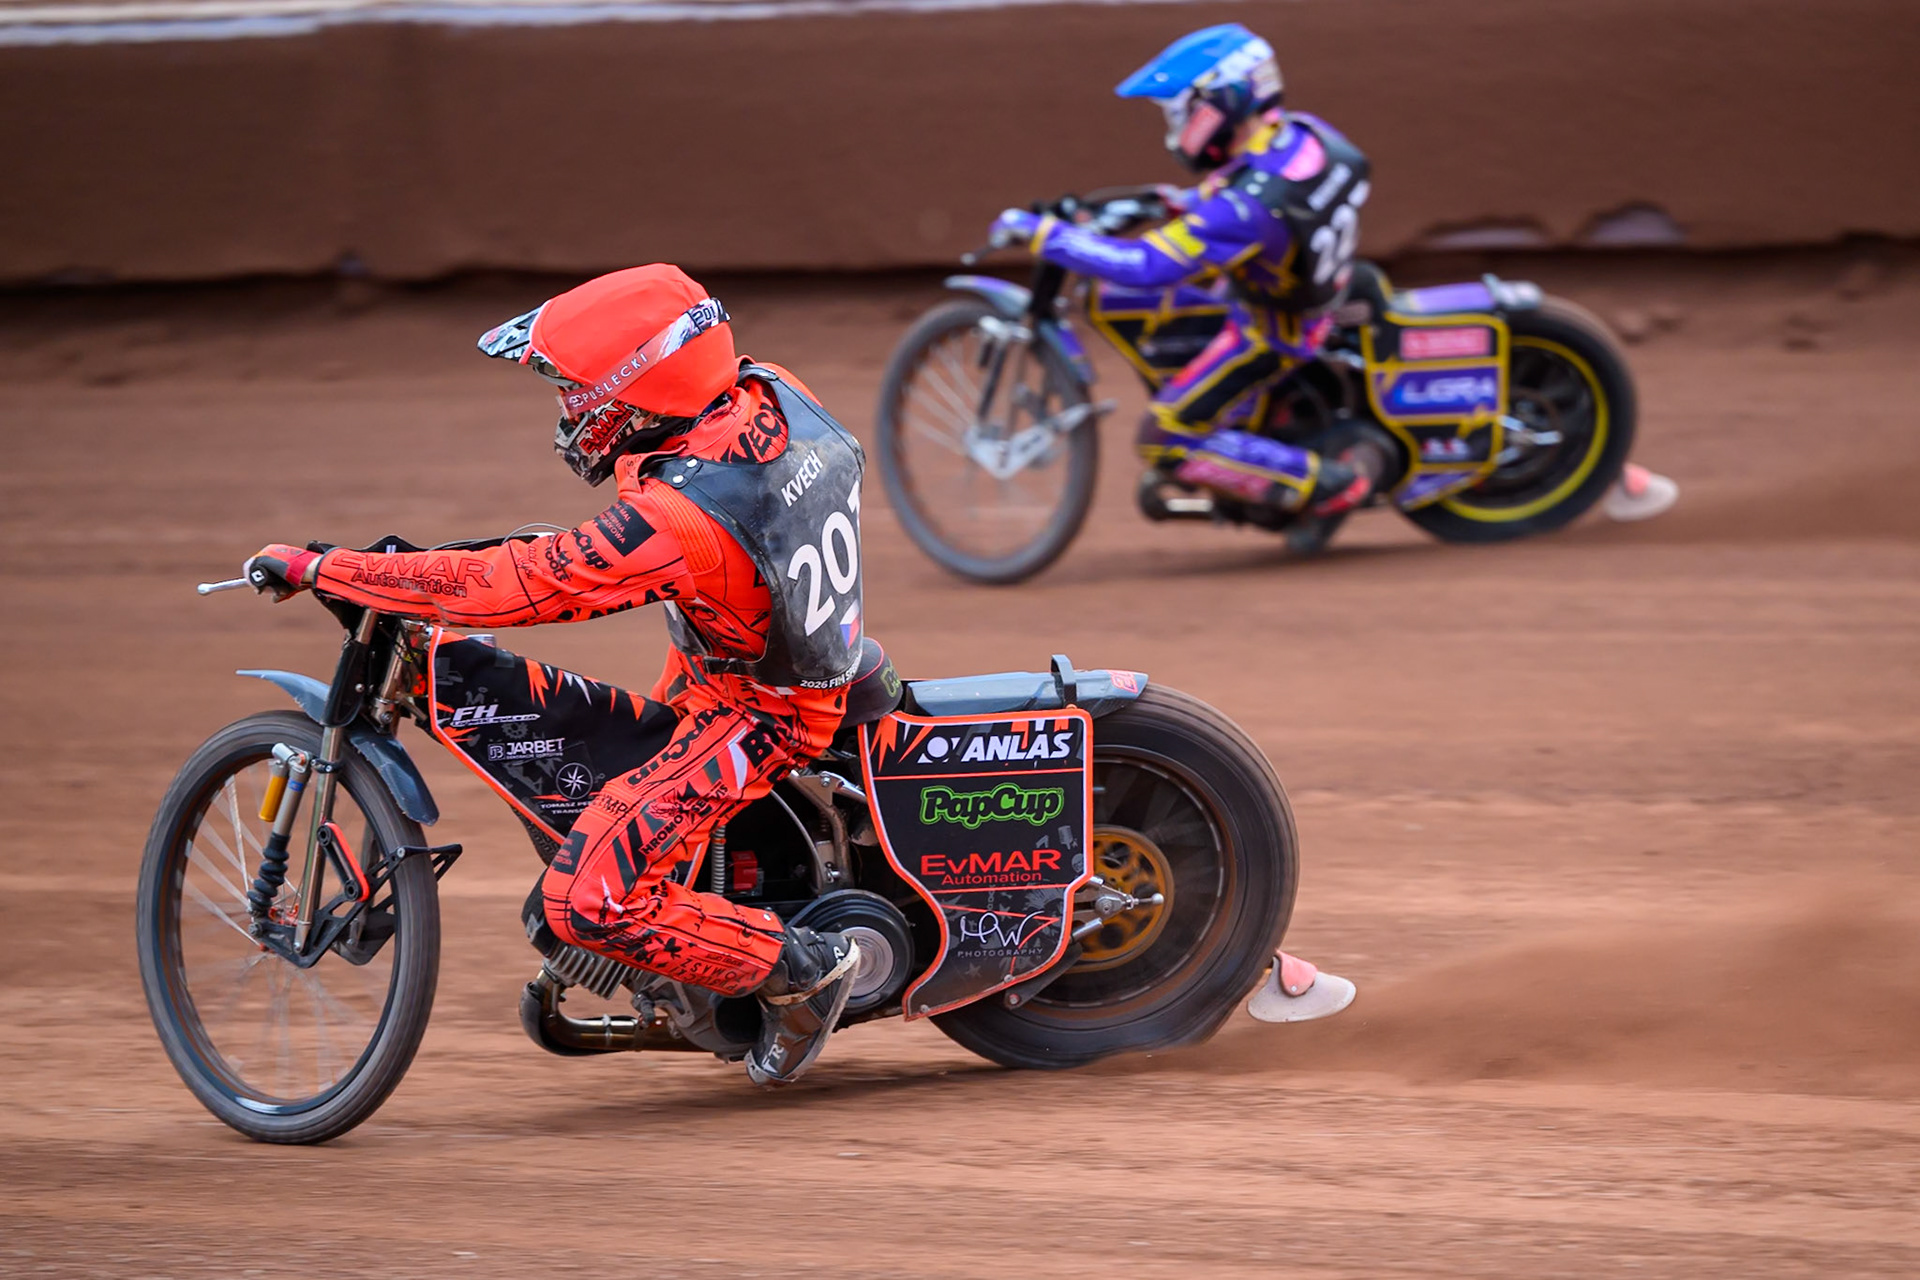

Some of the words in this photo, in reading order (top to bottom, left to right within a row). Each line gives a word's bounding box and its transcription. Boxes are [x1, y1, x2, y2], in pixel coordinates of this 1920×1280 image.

[692, 306, 717, 326] 201
[781, 450, 824, 507] KVECH
[351, 569, 468, 599] Automation
[800, 679, 829, 689] 2026
[452, 704, 499, 721] FH
[506, 737, 566, 756] JARBET
[961, 732, 1074, 763] ANLAS
[541, 801, 575, 809] TOMASZ
[691, 784, 729, 814] SEVIS
[920, 782, 1065, 829] PapCup
[941, 871, 1043, 886] Automation
[957, 948, 1044, 959] PHOTOGRAPHY
